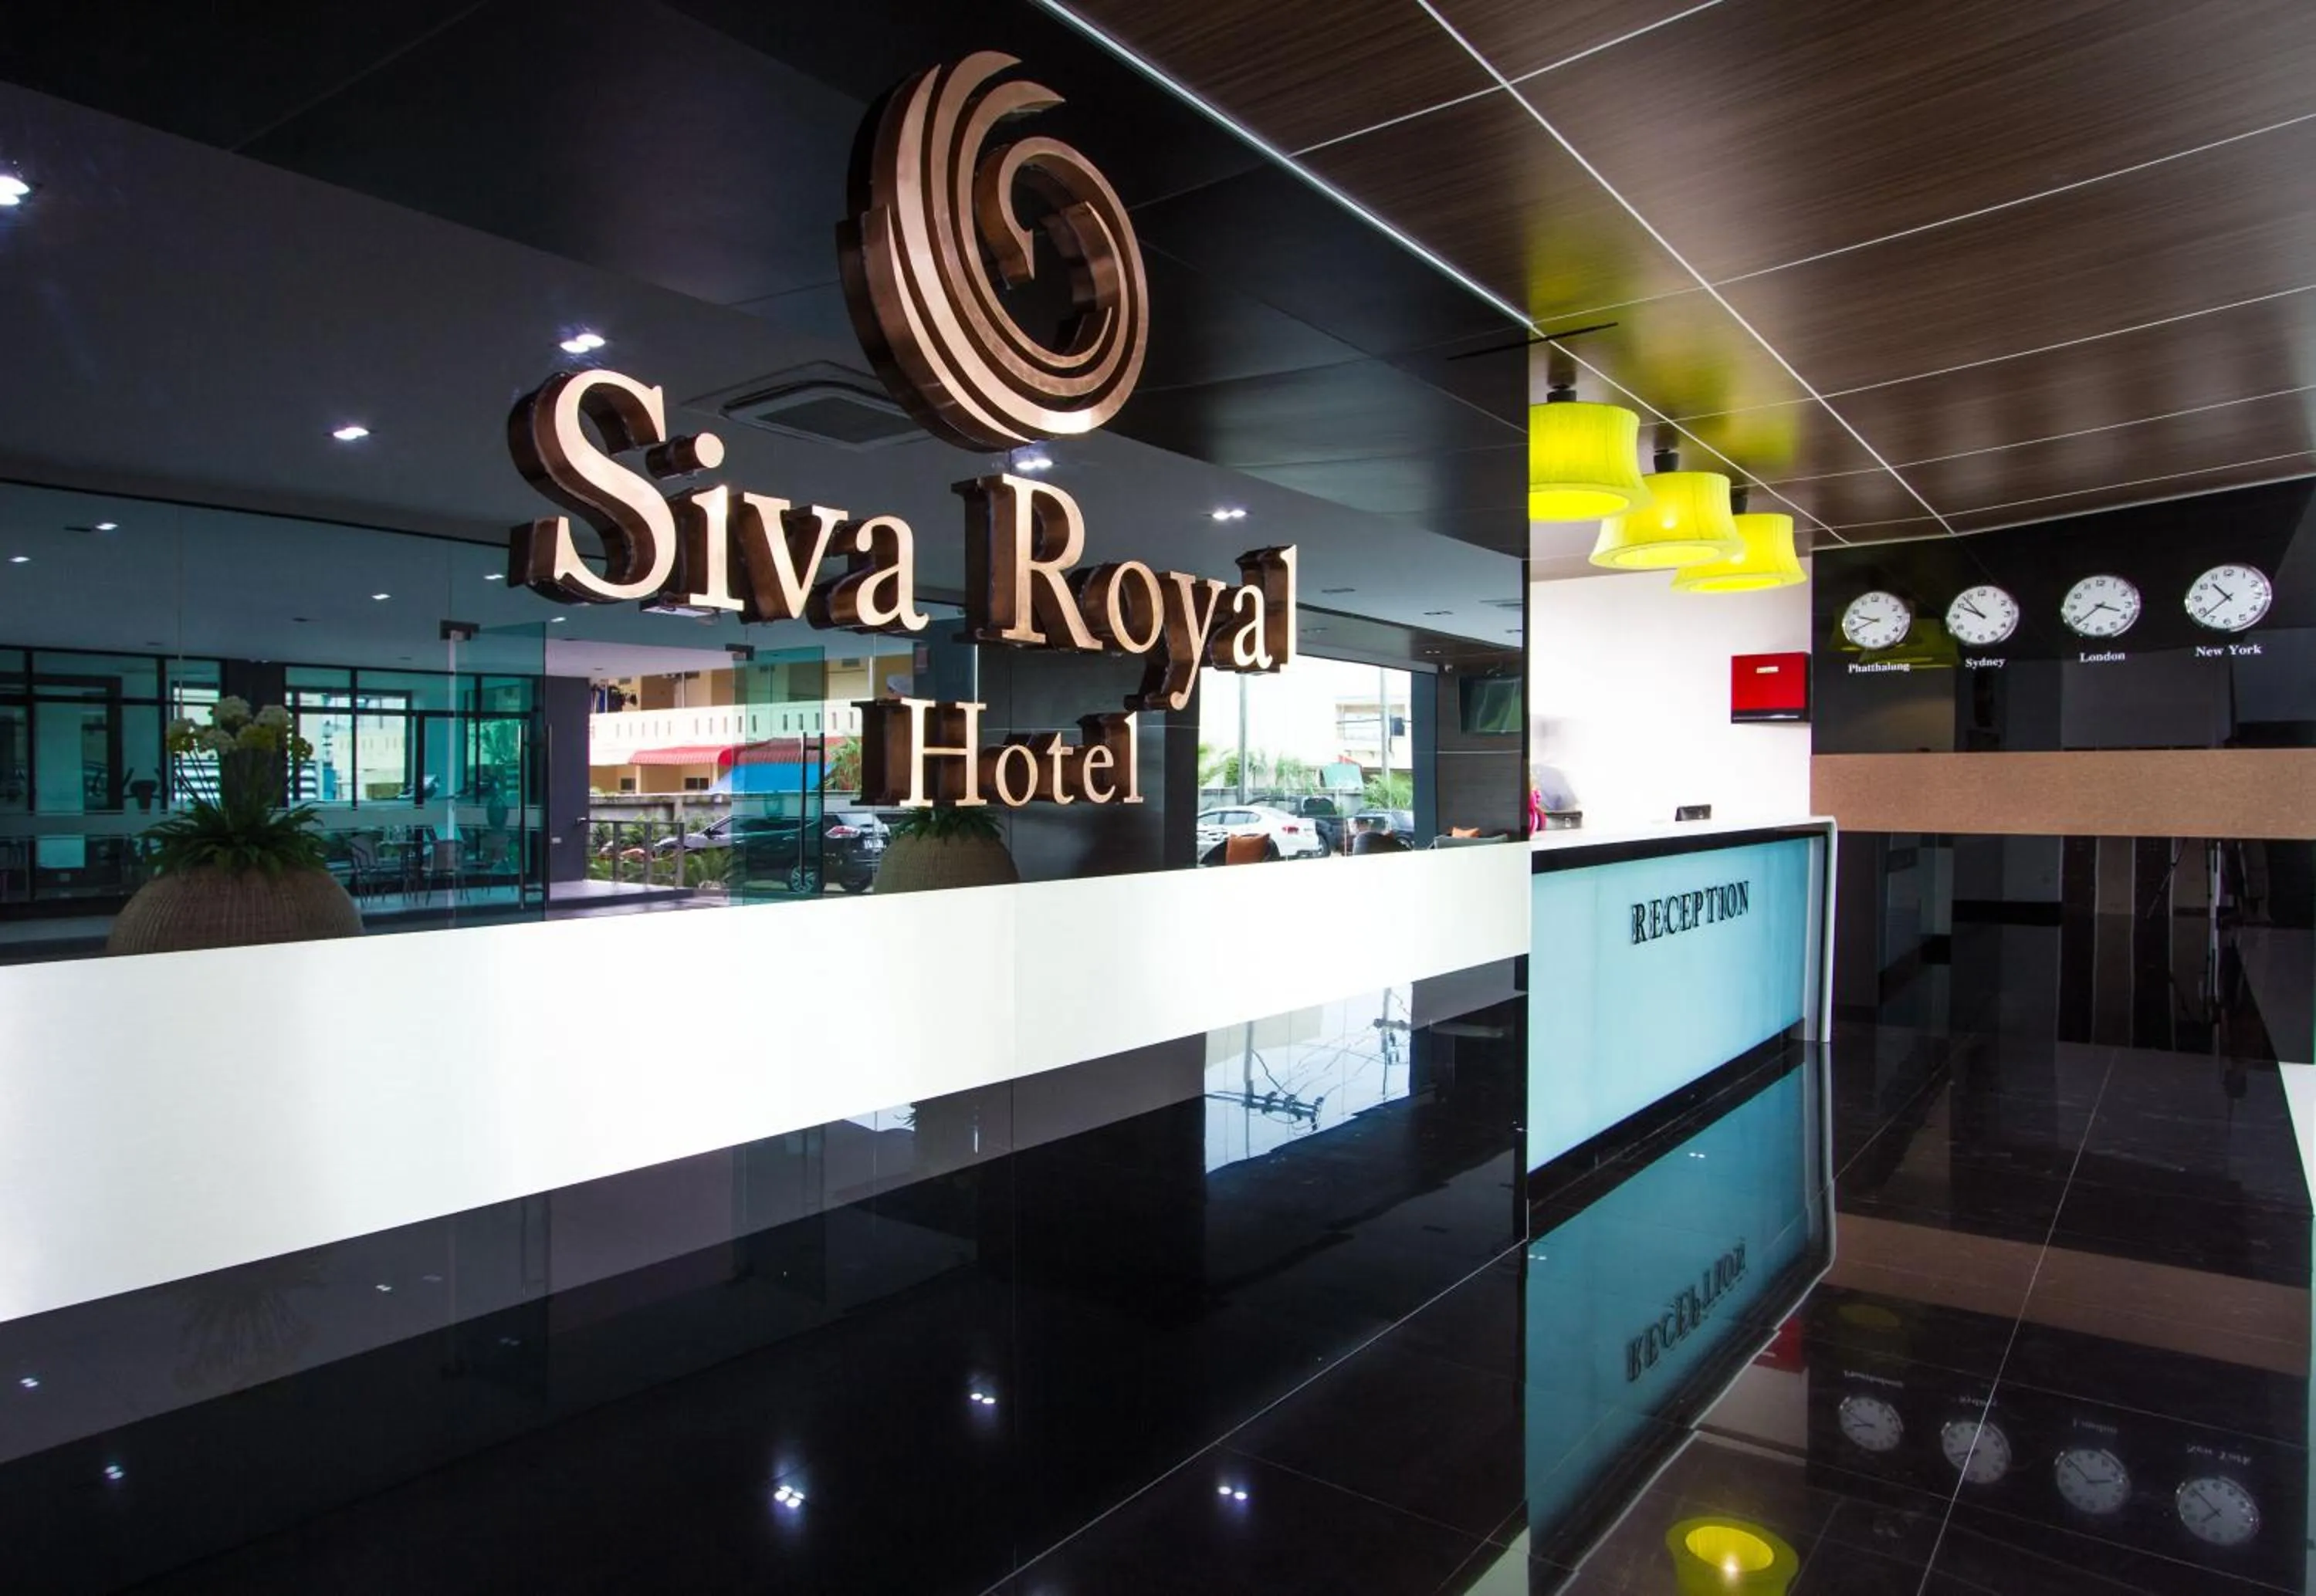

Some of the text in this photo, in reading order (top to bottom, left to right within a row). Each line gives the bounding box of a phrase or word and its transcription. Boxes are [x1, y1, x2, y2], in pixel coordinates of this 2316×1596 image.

[551, 369, 1298, 712] Siva Royal
[2079, 650, 2125, 663] London
[2194, 644, 2262, 658] New York
[1848, 661, 1910, 674] Phatthalung
[1964, 658, 2006, 670] Sydney
[899, 697, 1144, 808] Hotel
[1630, 881, 1749, 945] RECEPTION
